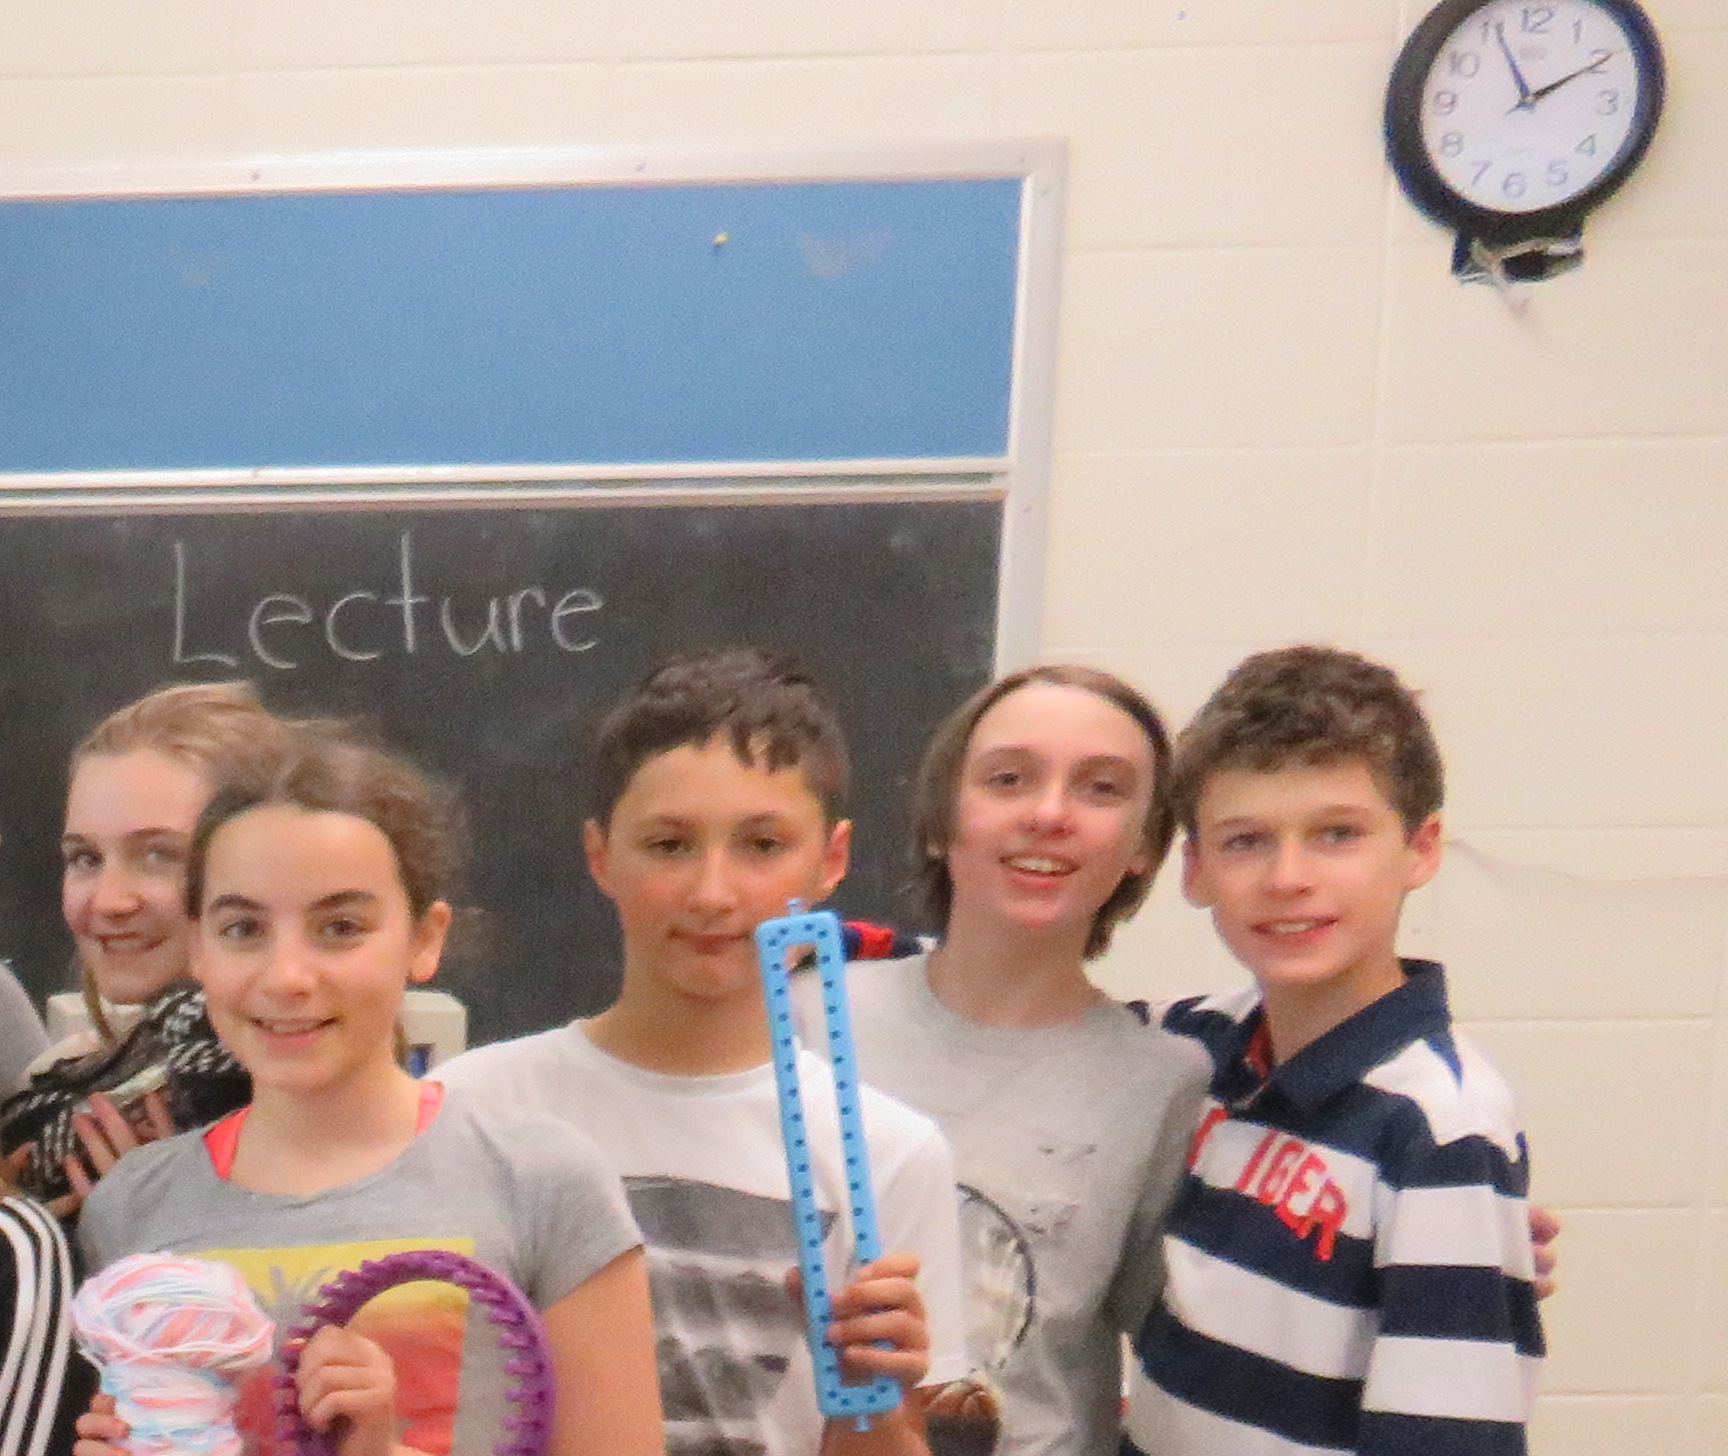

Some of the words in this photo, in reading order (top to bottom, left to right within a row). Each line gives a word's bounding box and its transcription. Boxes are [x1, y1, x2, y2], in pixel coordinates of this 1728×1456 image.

[1518, 6, 1556, 35] 12
[1570, 18, 1583, 45] 1
[1448, 49, 1481, 79] 10
[1432, 89, 1458, 117] 9
[1594, 88, 1620, 117] 3
[1438, 129, 1465, 159] 8
[1573, 132, 1599, 158] 4
[1469, 159, 1494, 187] 7
[1500, 170, 1528, 199] 6
[1545, 158, 1570, 188] 5
[172, 532, 606, 670] Lecture
